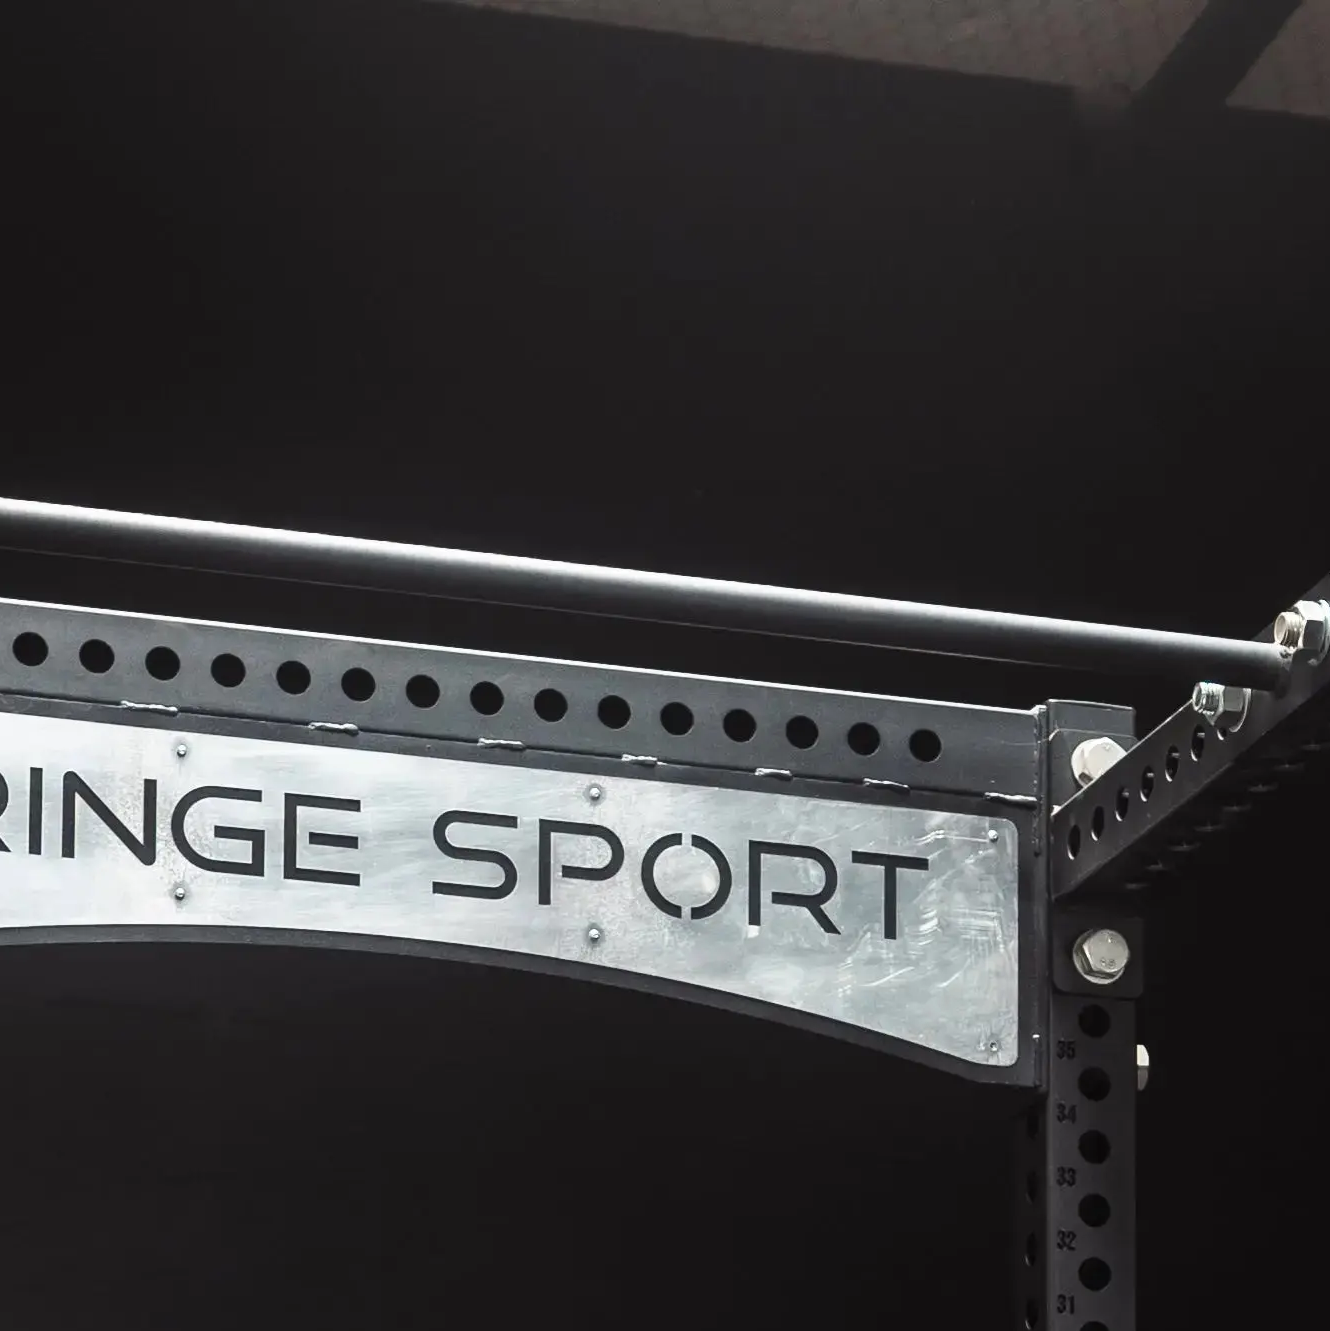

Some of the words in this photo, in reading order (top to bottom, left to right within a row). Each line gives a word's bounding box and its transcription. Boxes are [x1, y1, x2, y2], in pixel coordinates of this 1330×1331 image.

[432, 809, 930, 941] SPORT
[1056, 1040, 1077, 1060] 35
[1056, 1102, 1078, 1125] 34
[1056, 1166, 1077, 1188] 33
[1056, 1229, 1078, 1252] 32
[1056, 1293, 1075, 1315] 31
